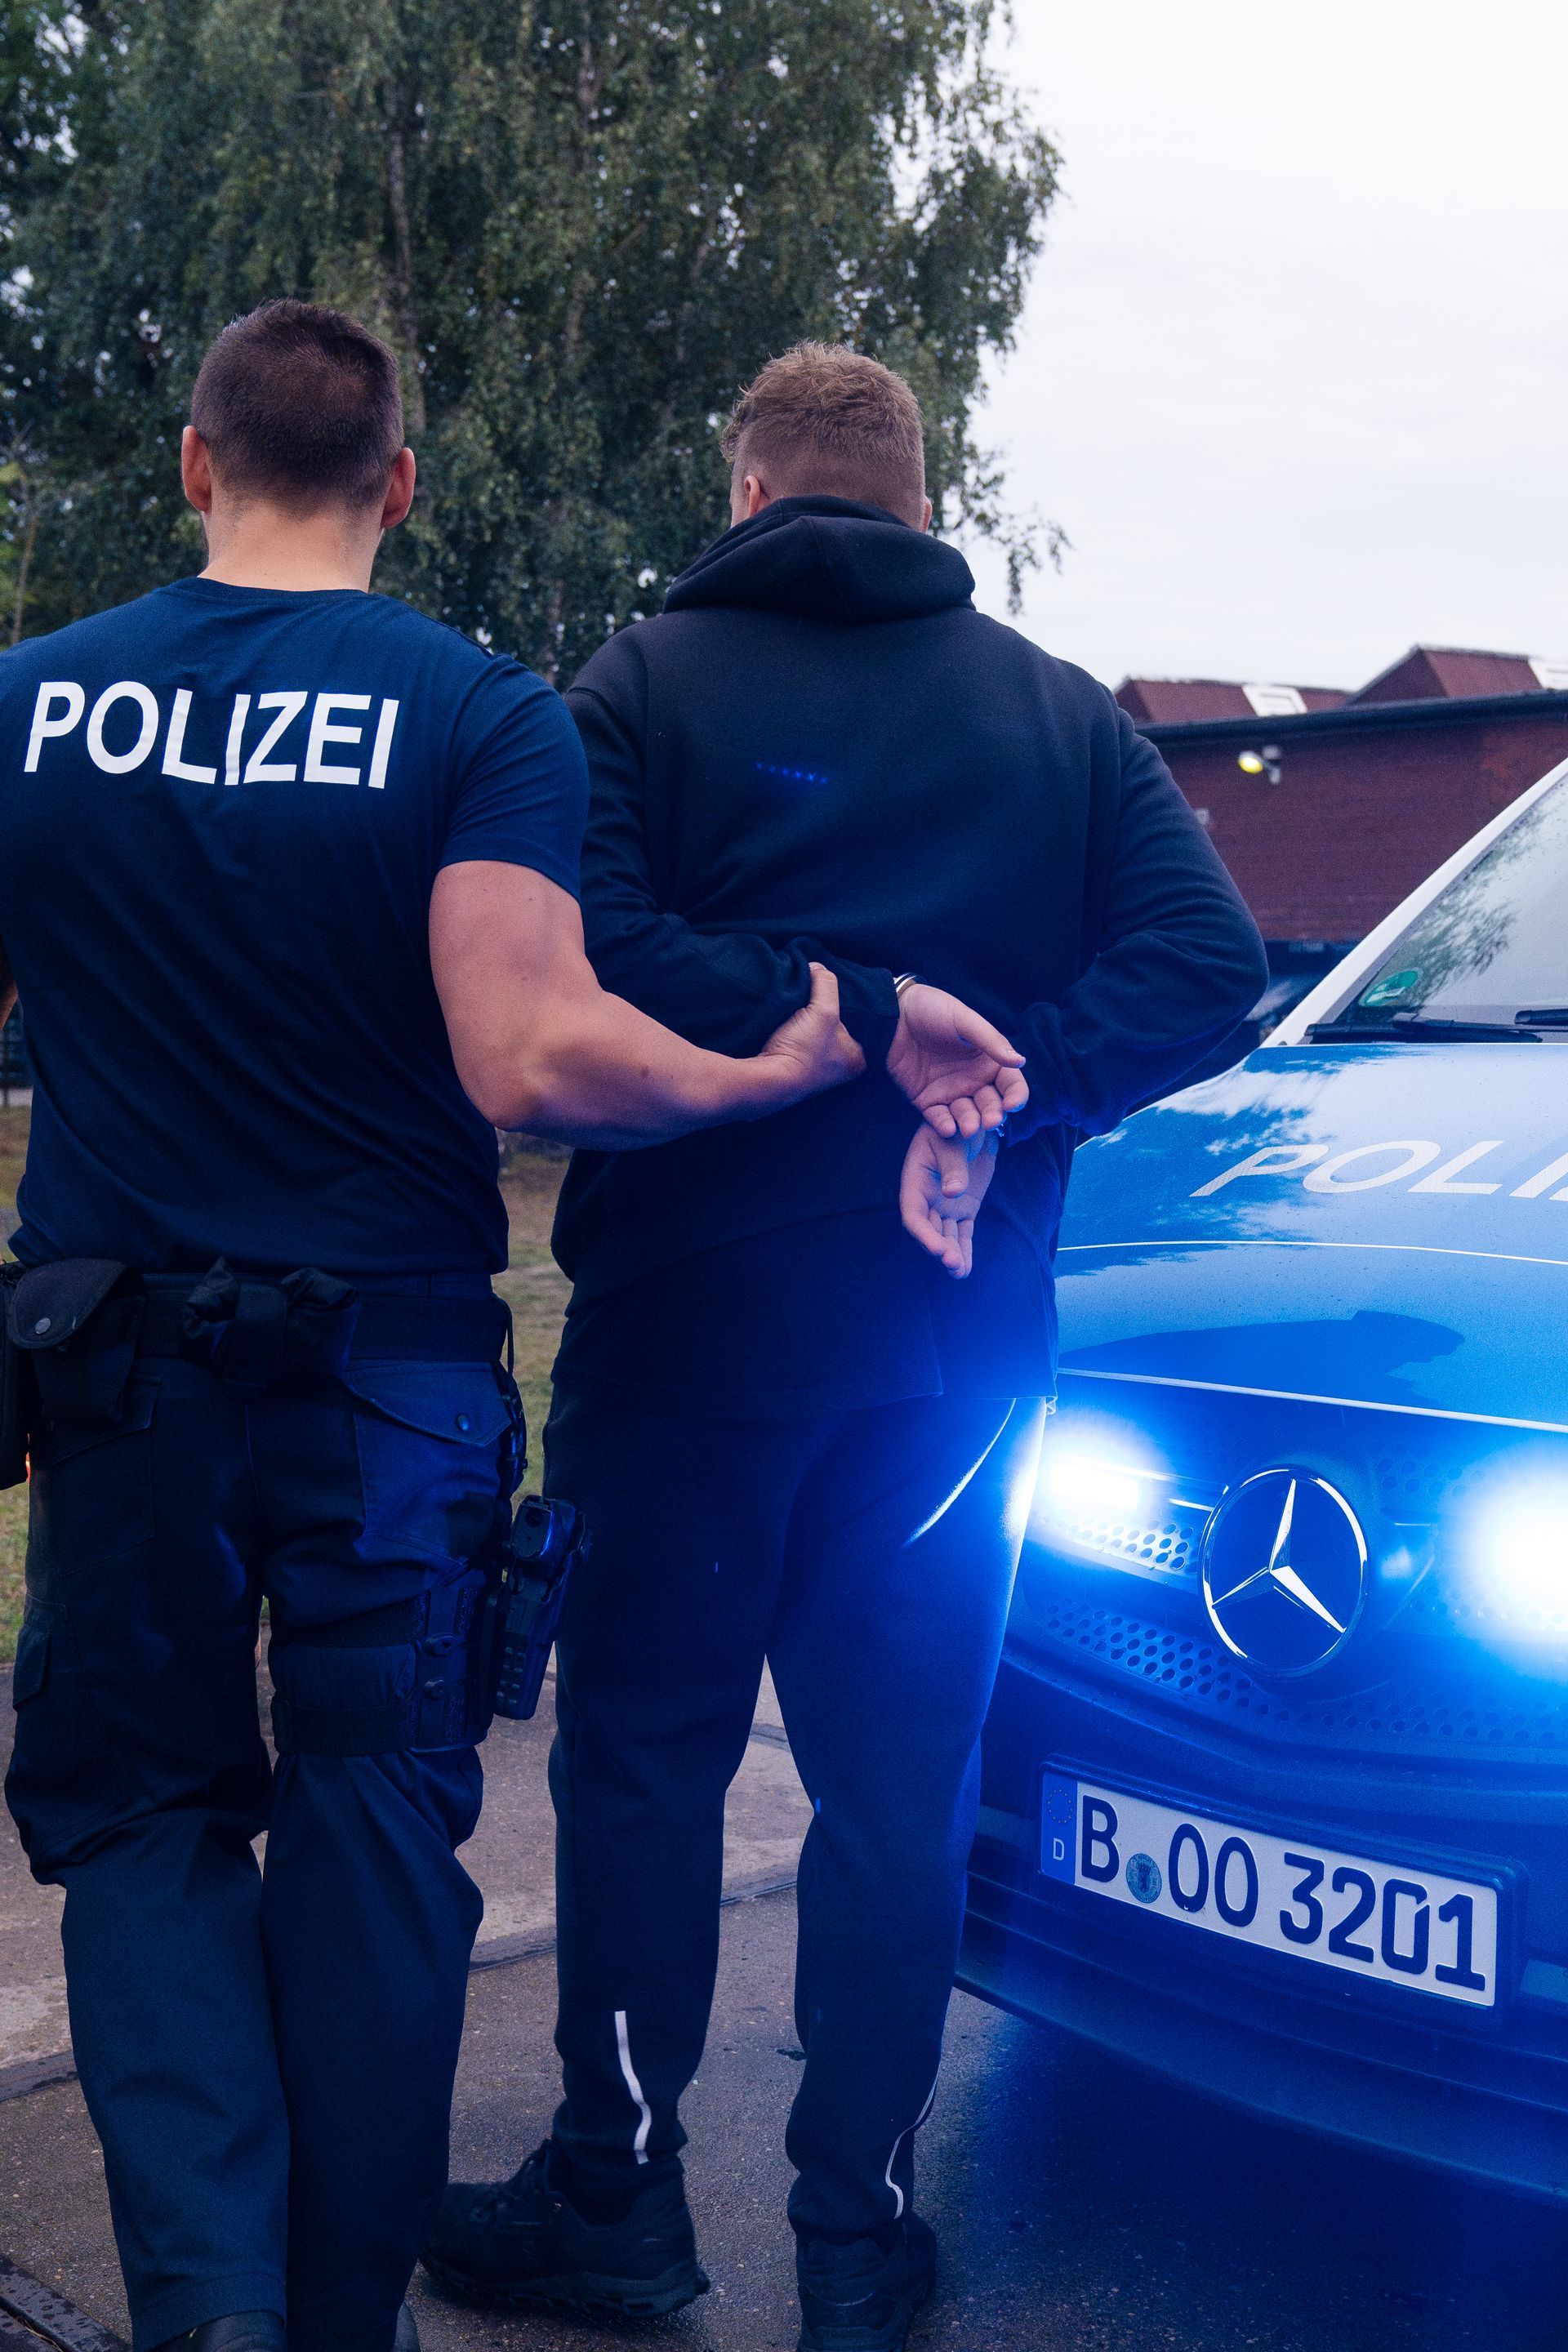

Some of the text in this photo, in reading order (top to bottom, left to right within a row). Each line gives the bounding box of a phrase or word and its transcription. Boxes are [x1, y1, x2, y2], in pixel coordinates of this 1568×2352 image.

[24, 680, 399, 789] POLIZEI
[1189, 1139, 1568, 1202] POLI
[1053, 1838, 1065, 1861] D
[1081, 1794, 1120, 1883] B
[1279, 1851, 1486, 1992] 3201
